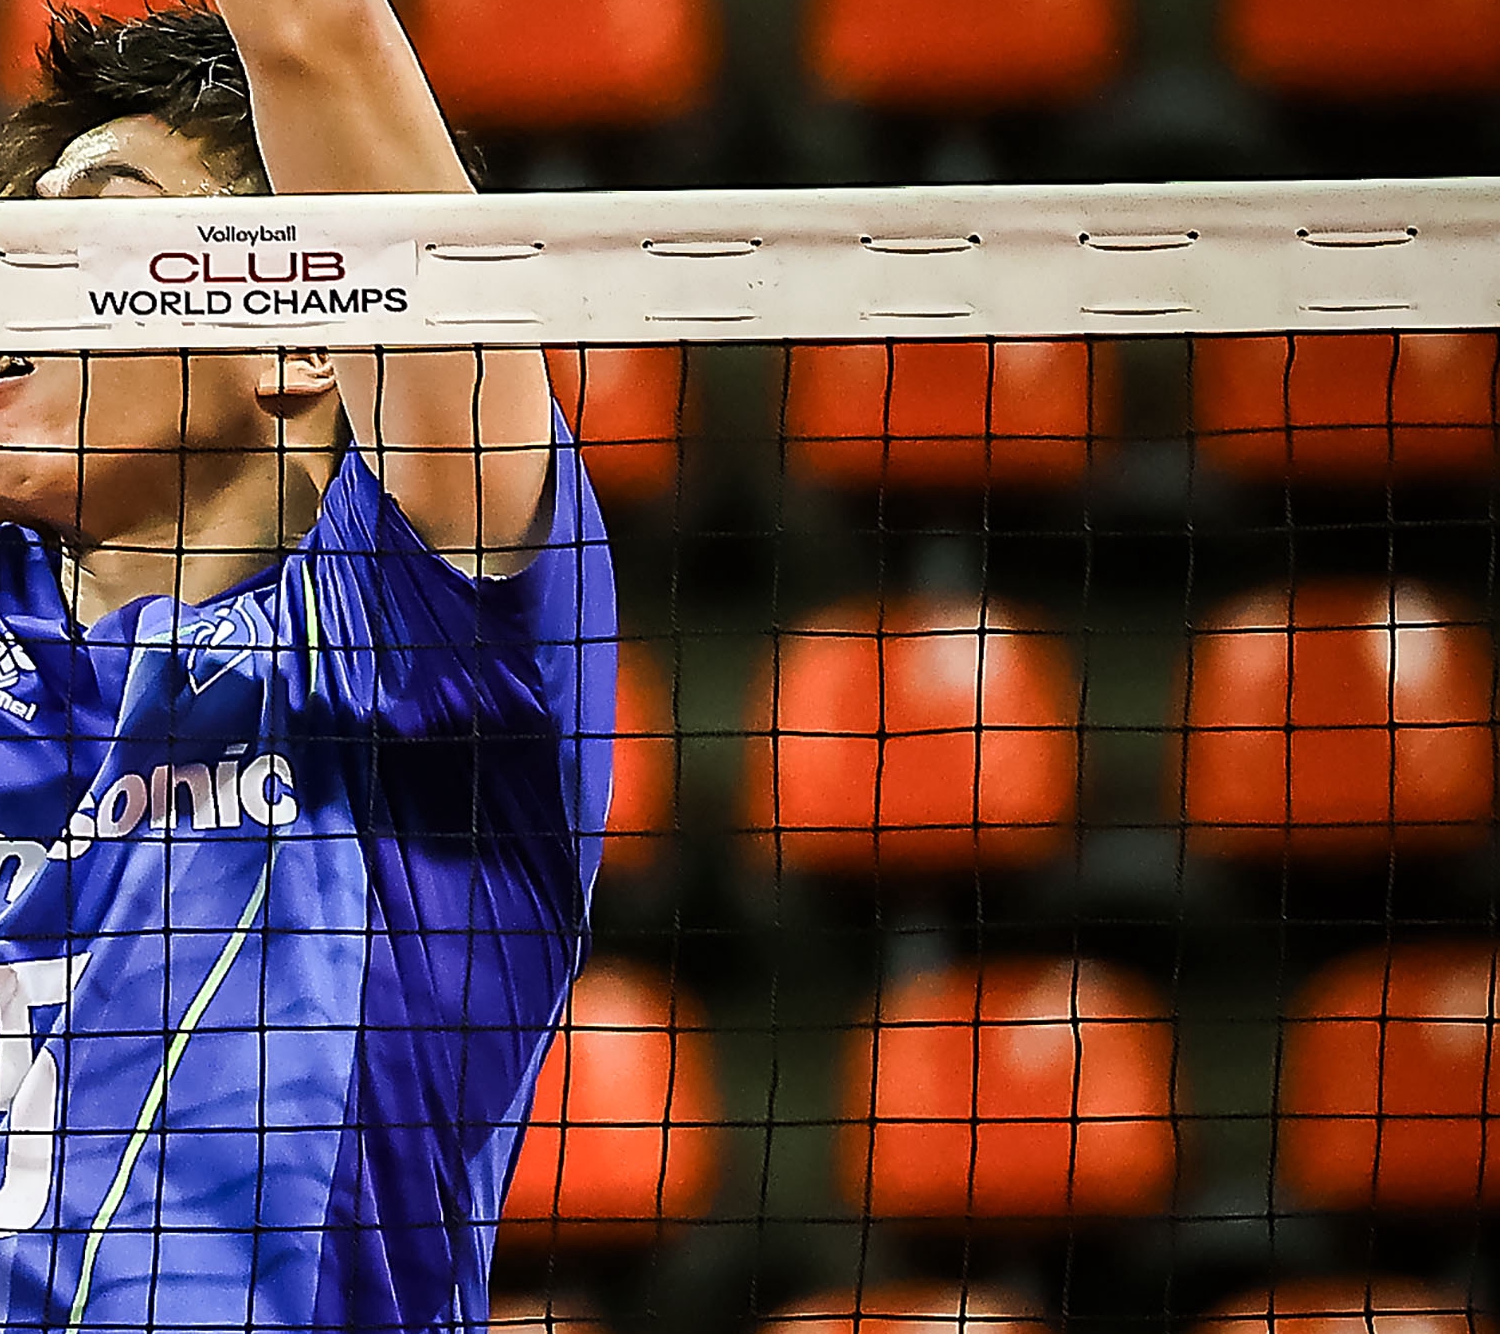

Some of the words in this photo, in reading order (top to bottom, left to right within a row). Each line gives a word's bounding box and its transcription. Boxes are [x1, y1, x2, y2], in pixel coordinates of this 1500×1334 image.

[197, 225, 297, 246] Volleyball
[149, 251, 346, 284] CLUB
[88, 290, 232, 316] WORLD
[242, 287, 409, 315] CHAMPS
